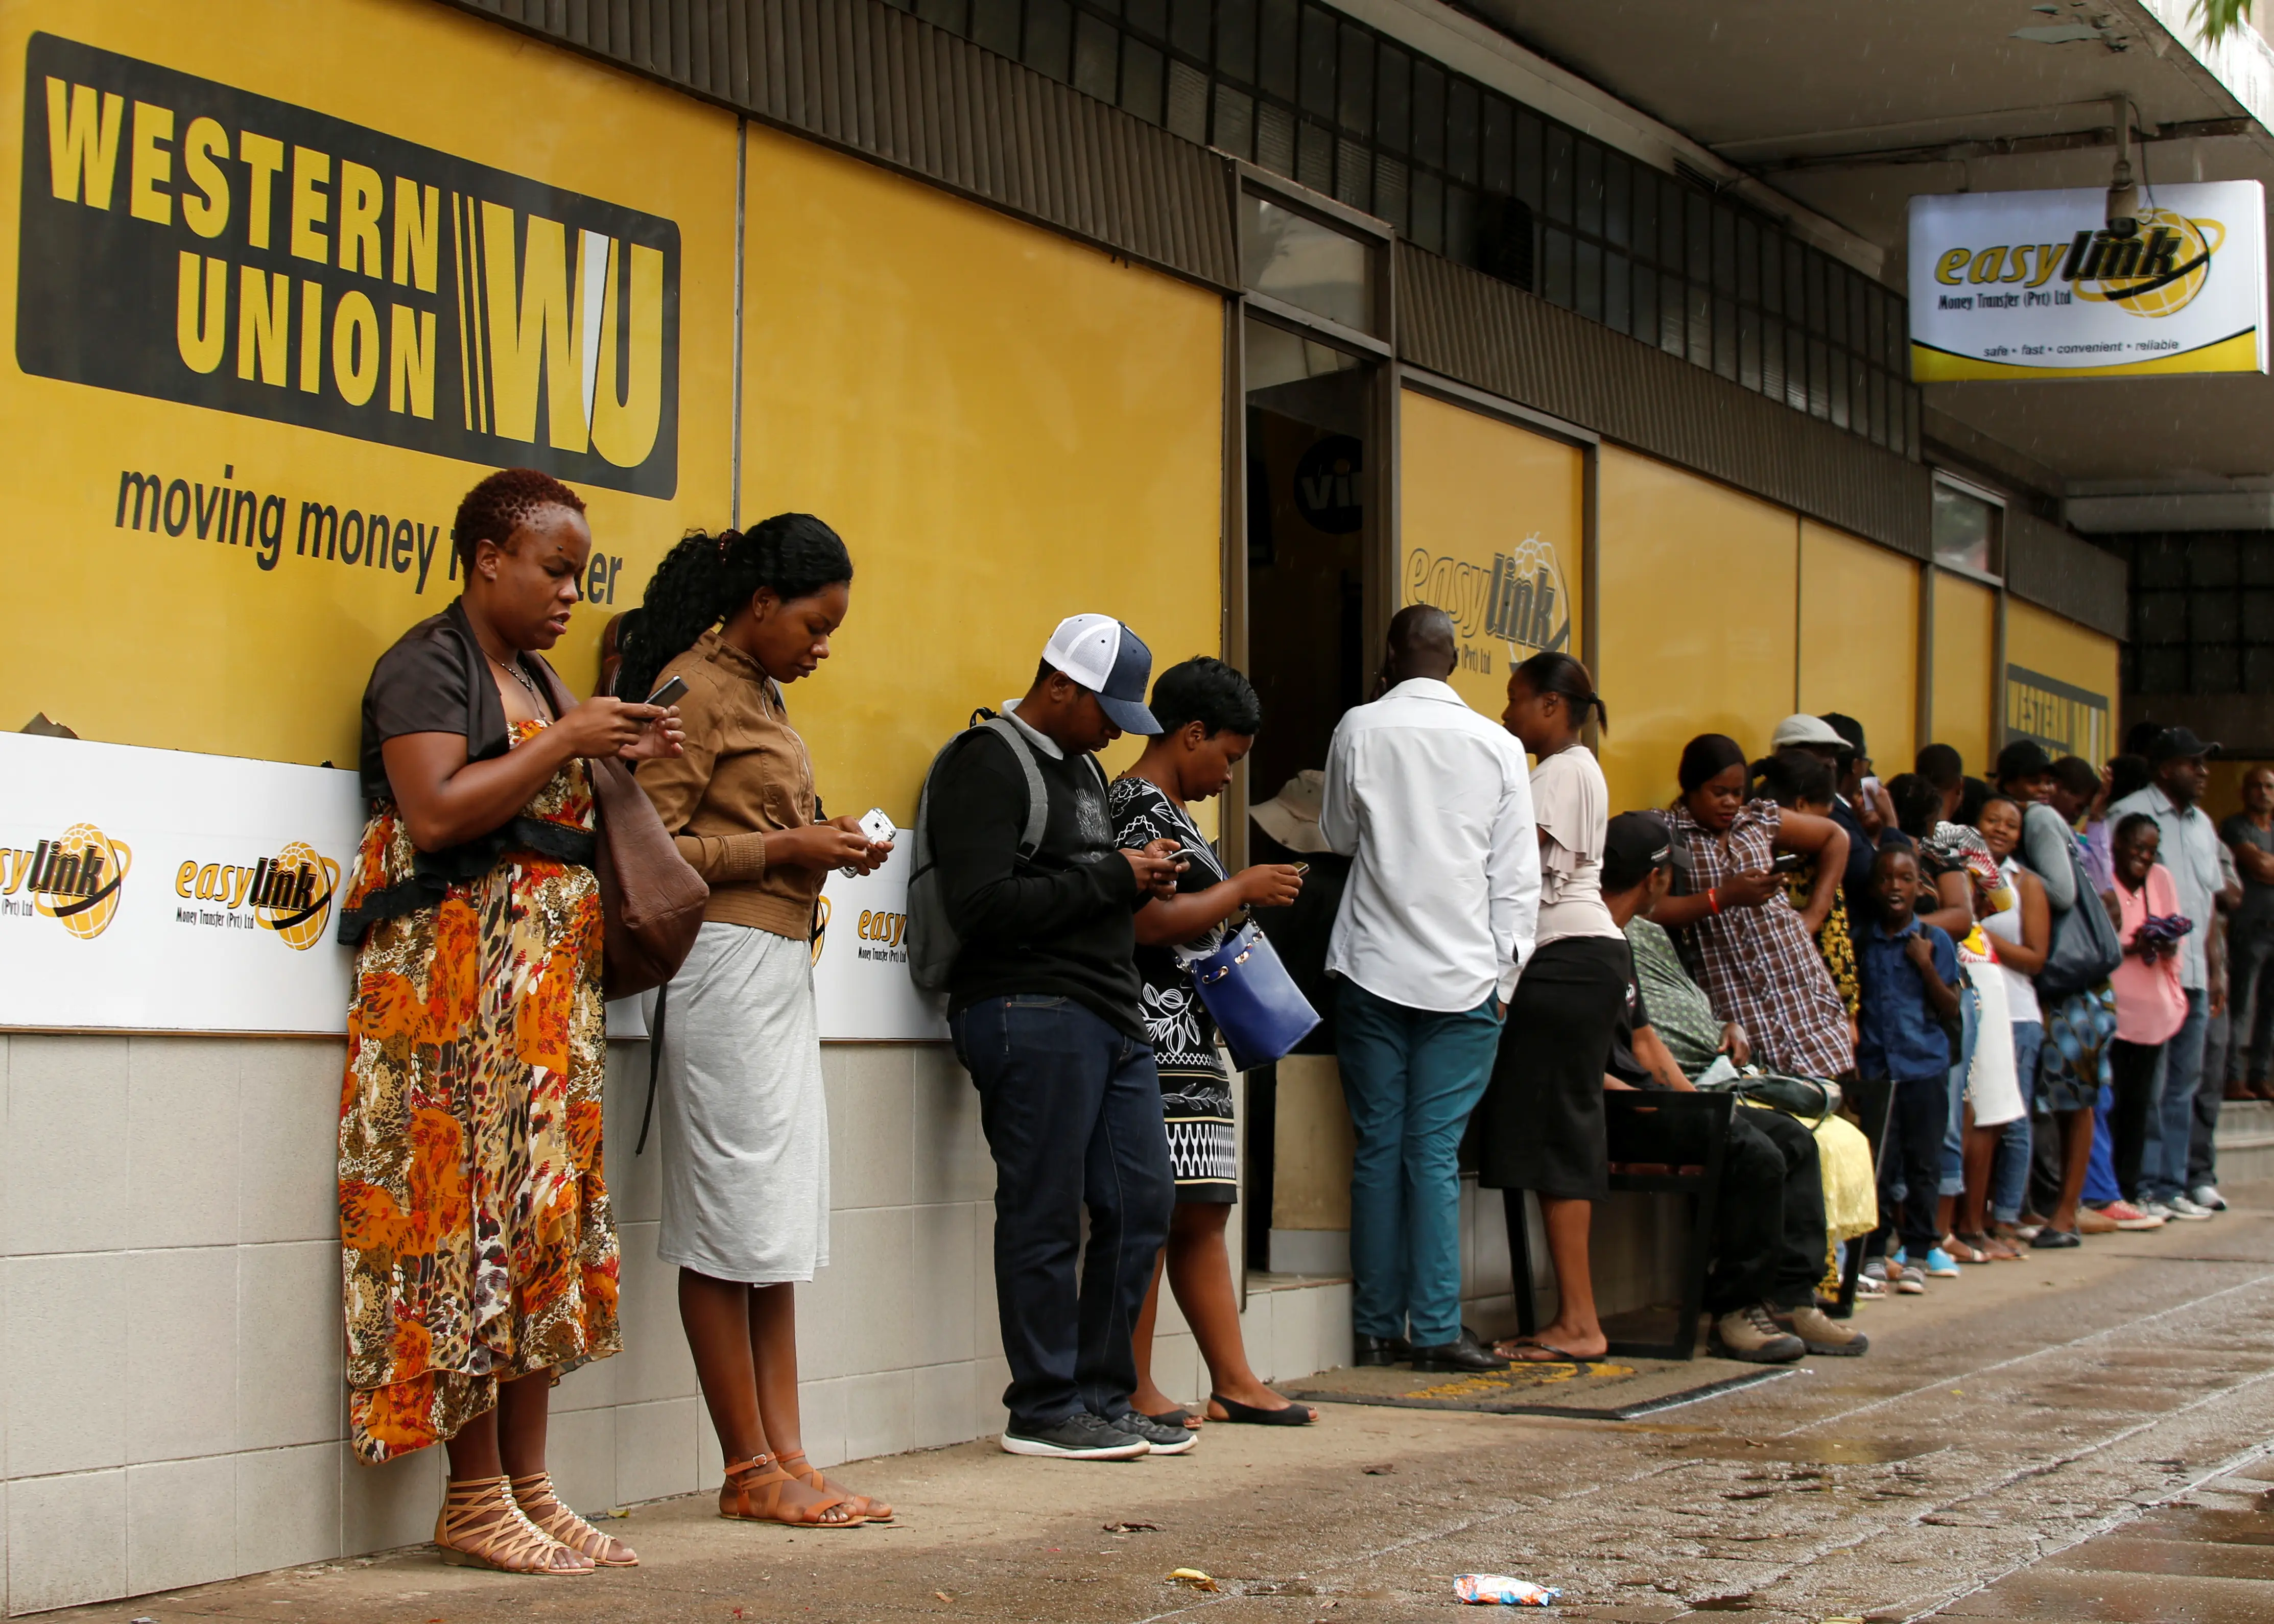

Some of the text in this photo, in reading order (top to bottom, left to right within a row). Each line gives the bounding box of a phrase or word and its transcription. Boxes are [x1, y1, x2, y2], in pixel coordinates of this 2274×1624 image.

[46, 76, 440, 294] WESTERN
[1934, 227, 2182, 289] easylink
[1938, 290, 2071, 311] Money Transfer (Pvt) Ltd
[177, 250, 436, 420] UNION
[481, 200, 664, 468] WU
[1983, 339, 2180, 357] safe fast convenient reliable
[115, 464, 286, 571] moving
[297, 499, 438, 596] money
[1405, 548, 1555, 650] easylink
[1461, 643, 1478, 674] (Pvt)
[1480, 647, 1491, 675] Ltd
[0, 840, 105, 897] sylink
[175, 857, 317, 911] easylink
[2, 898, 33, 917] (Pvt) Ltd
[176, 906, 254, 929] Money Transfer (Pvt) Ltd
[858, 946, 871, 961] Money
[872, 948, 888, 963] Transfer
[889, 949, 899, 963] (Pvt)
